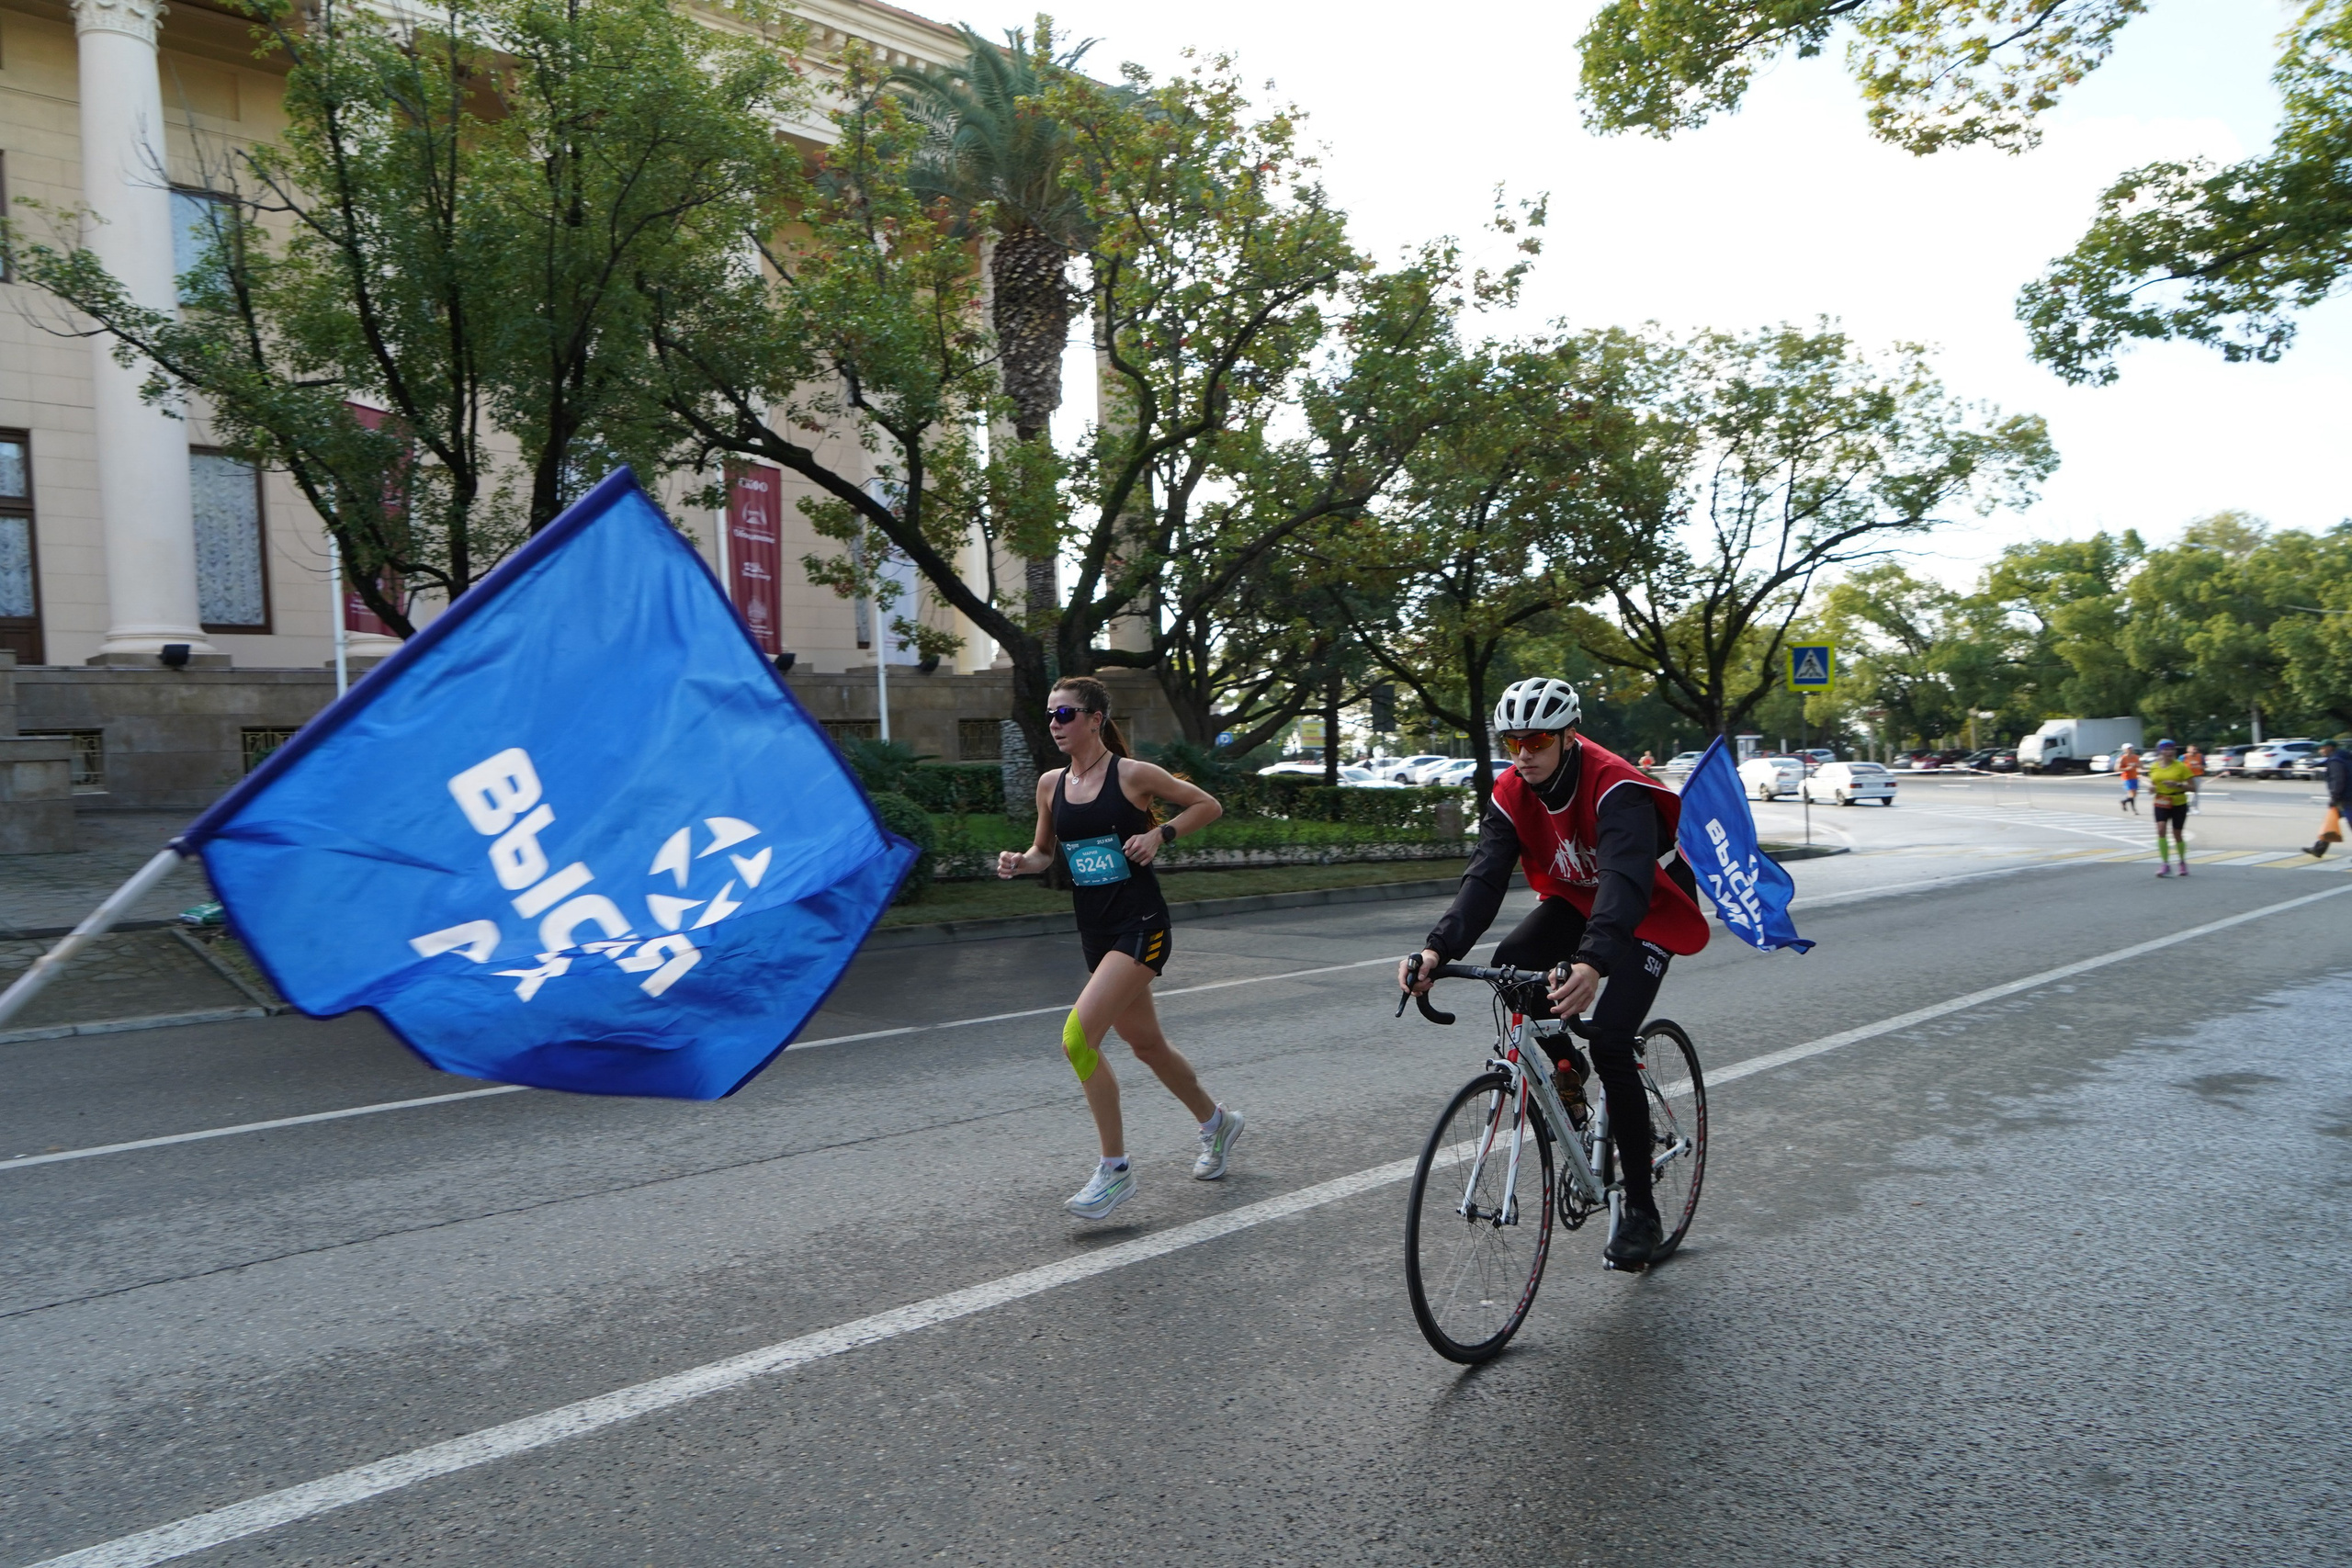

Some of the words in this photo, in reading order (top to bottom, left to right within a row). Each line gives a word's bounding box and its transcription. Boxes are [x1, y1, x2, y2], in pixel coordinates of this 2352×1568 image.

[447, 748, 702, 998] ВЫСЯ
[1076, 853, 1114, 874] 5241
[1644, 955, 1663, 977] SH
